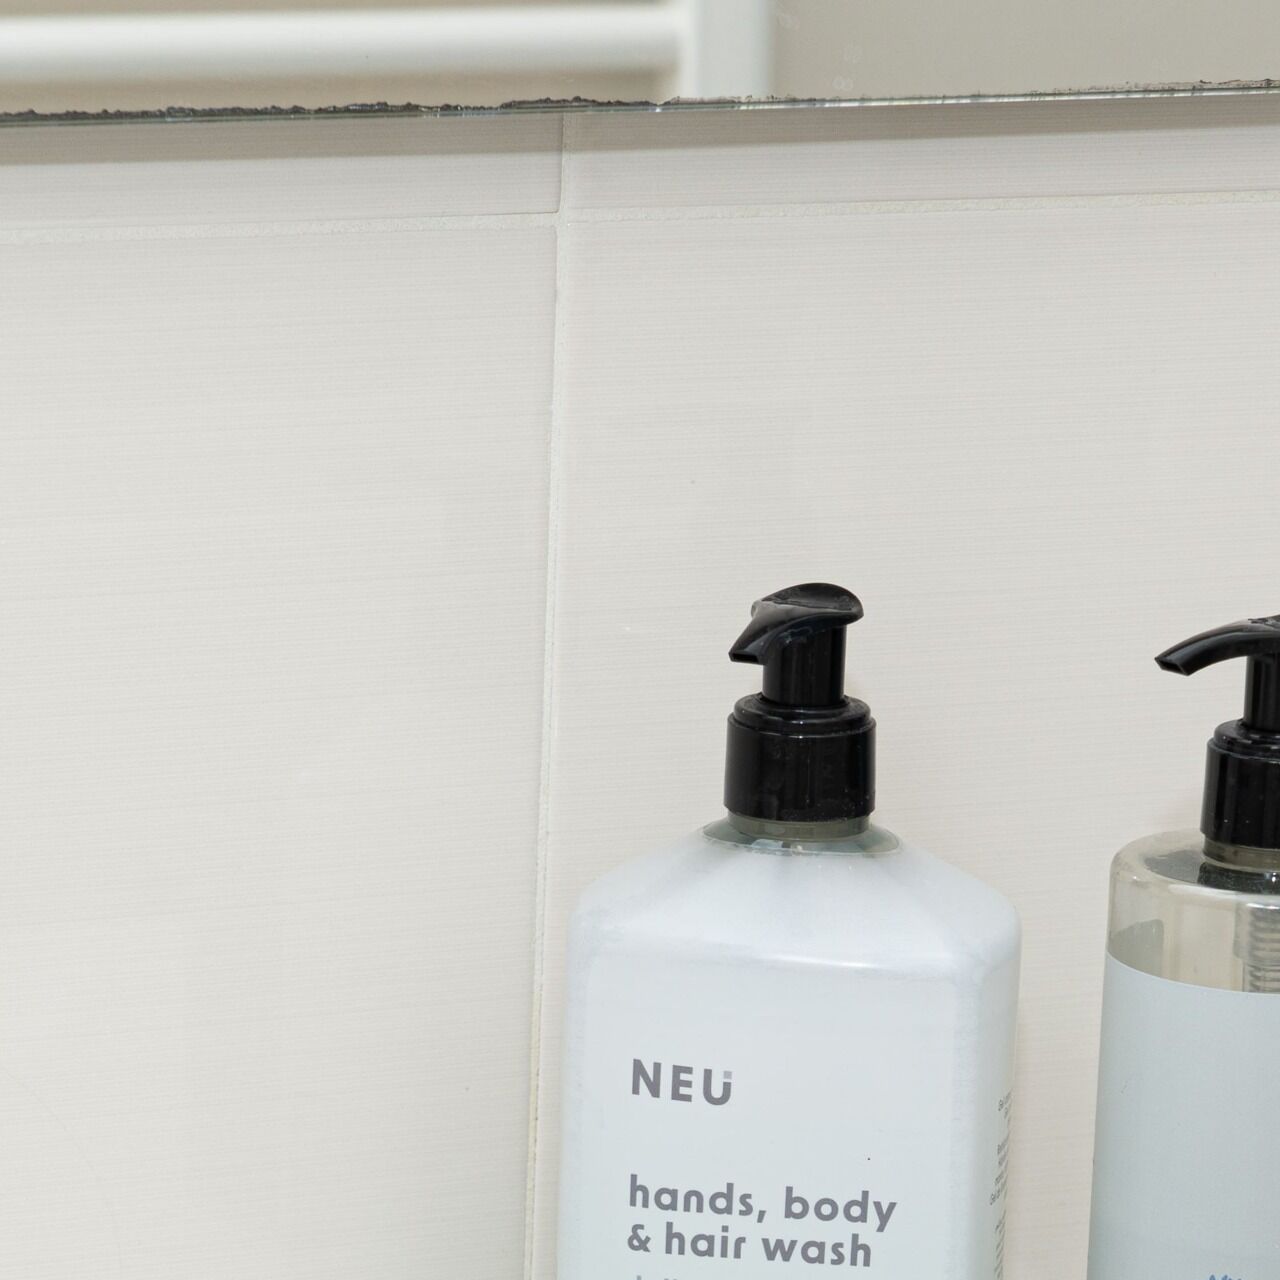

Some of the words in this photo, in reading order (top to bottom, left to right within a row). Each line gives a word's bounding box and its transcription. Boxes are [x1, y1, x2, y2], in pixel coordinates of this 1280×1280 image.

[632, 1059, 732, 1105] NEU
[630, 1174, 766, 1224] hands,
[785, 1186, 897, 1232] body
[628, 1224, 651, 1252] &
[665, 1222, 746, 1259] hair
[762, 1233, 872, 1267] wash
